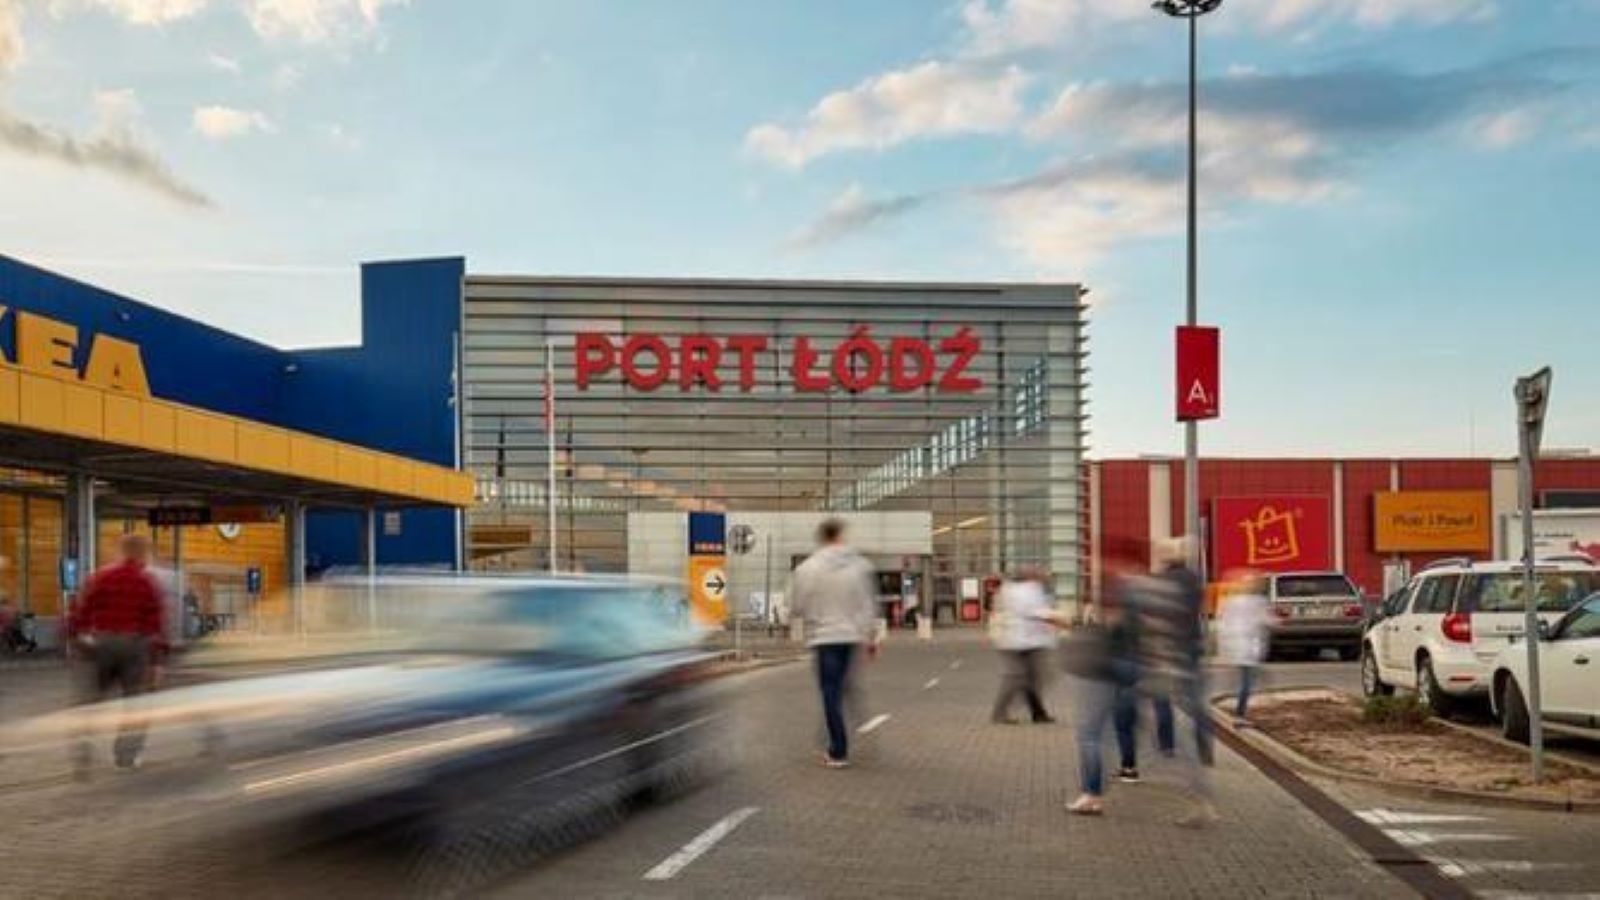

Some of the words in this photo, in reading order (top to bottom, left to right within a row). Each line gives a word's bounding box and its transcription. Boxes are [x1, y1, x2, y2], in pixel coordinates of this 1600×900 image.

[0, 304, 151, 399] EA
[575, 332, 767, 392] PORT
[791, 325, 983, 393] ŁÓDŹ
[1187, 379, 1207, 403] A
